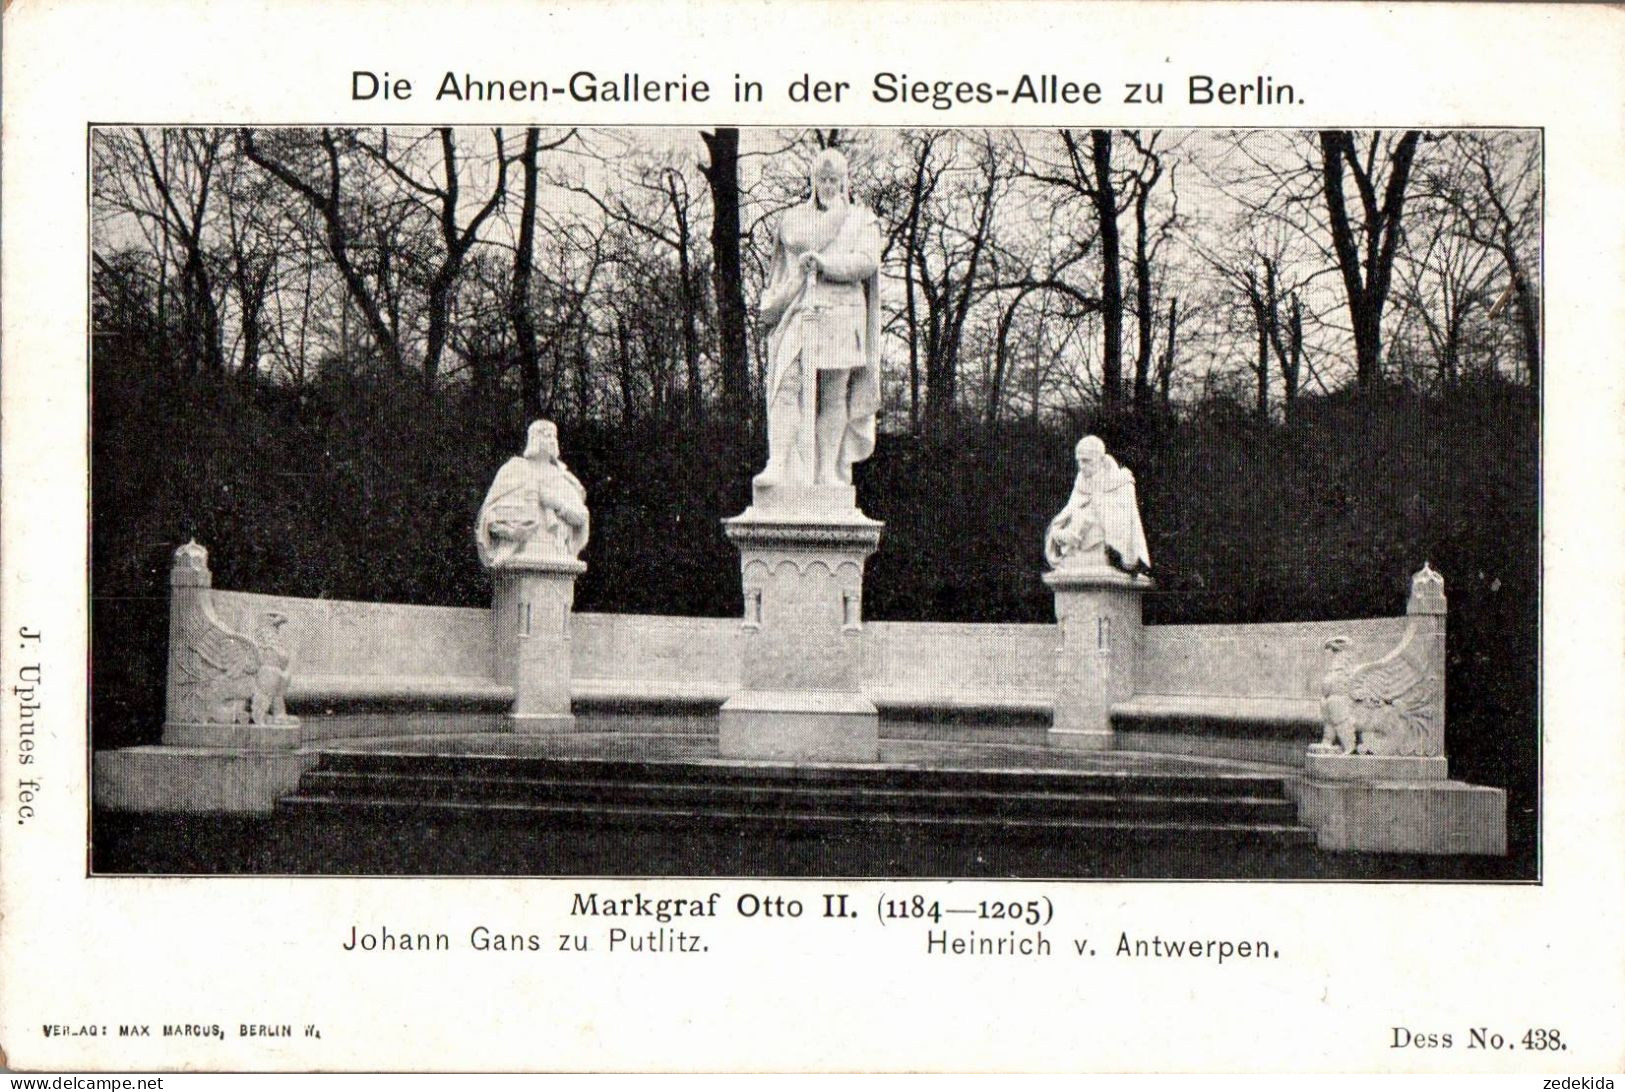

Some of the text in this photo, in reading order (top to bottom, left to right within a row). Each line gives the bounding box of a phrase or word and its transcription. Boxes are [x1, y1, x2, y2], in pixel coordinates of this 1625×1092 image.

[353, 71, 1305, 110] Die Ahnen-Gallerie in der Sieges-Allee zu Berlin.
[14, 626, 42, 825] J. Uphues fec.
[571, 892, 721, 923] Markgraf
[737, 893, 803, 918] Otto
[822, 894, 858, 919] II.
[343, 926, 708, 952] Johann Gans zu Putlitz.
[928, 930, 1280, 965] Heinrich v. Antwerpen.
[119, 1025, 150, 1037] MAX
[163, 1024, 225, 1041] MARCUS,
[239, 1024, 291, 1038] BERLIN
[1390, 1027, 1568, 1051] Dess No. 438.
